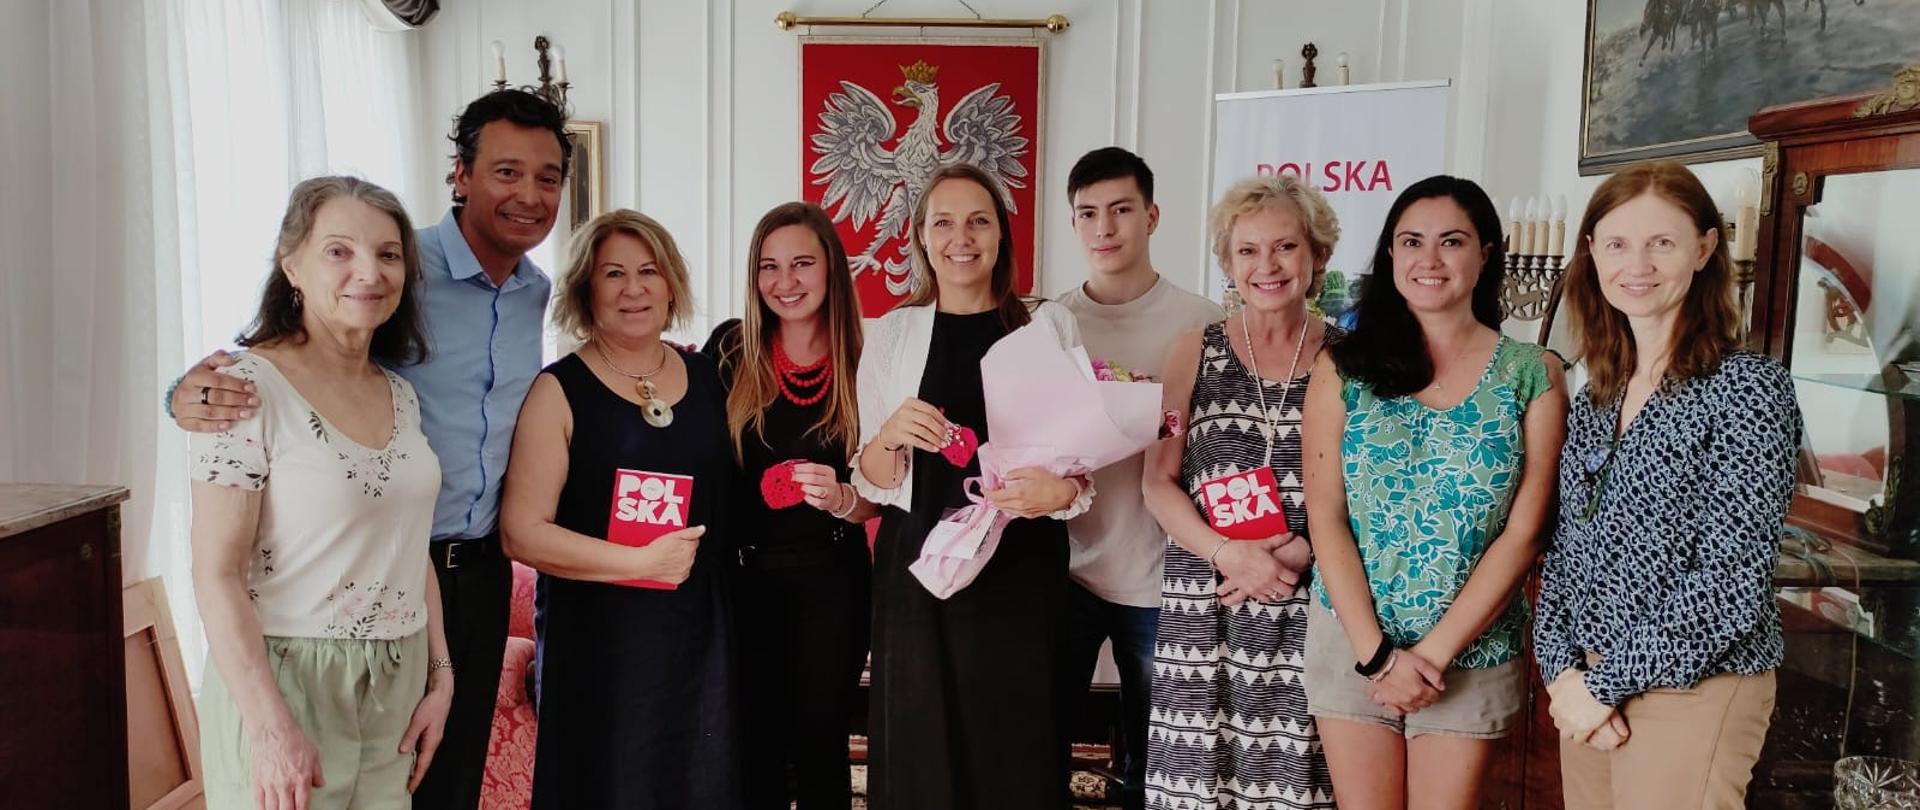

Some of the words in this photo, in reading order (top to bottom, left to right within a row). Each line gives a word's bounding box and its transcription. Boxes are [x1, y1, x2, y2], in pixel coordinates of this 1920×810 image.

[618, 474, 684, 504] POL
[1205, 474, 1270, 507] POL
[616, 497, 683, 527] SKA
[1213, 493, 1280, 527] SKA
